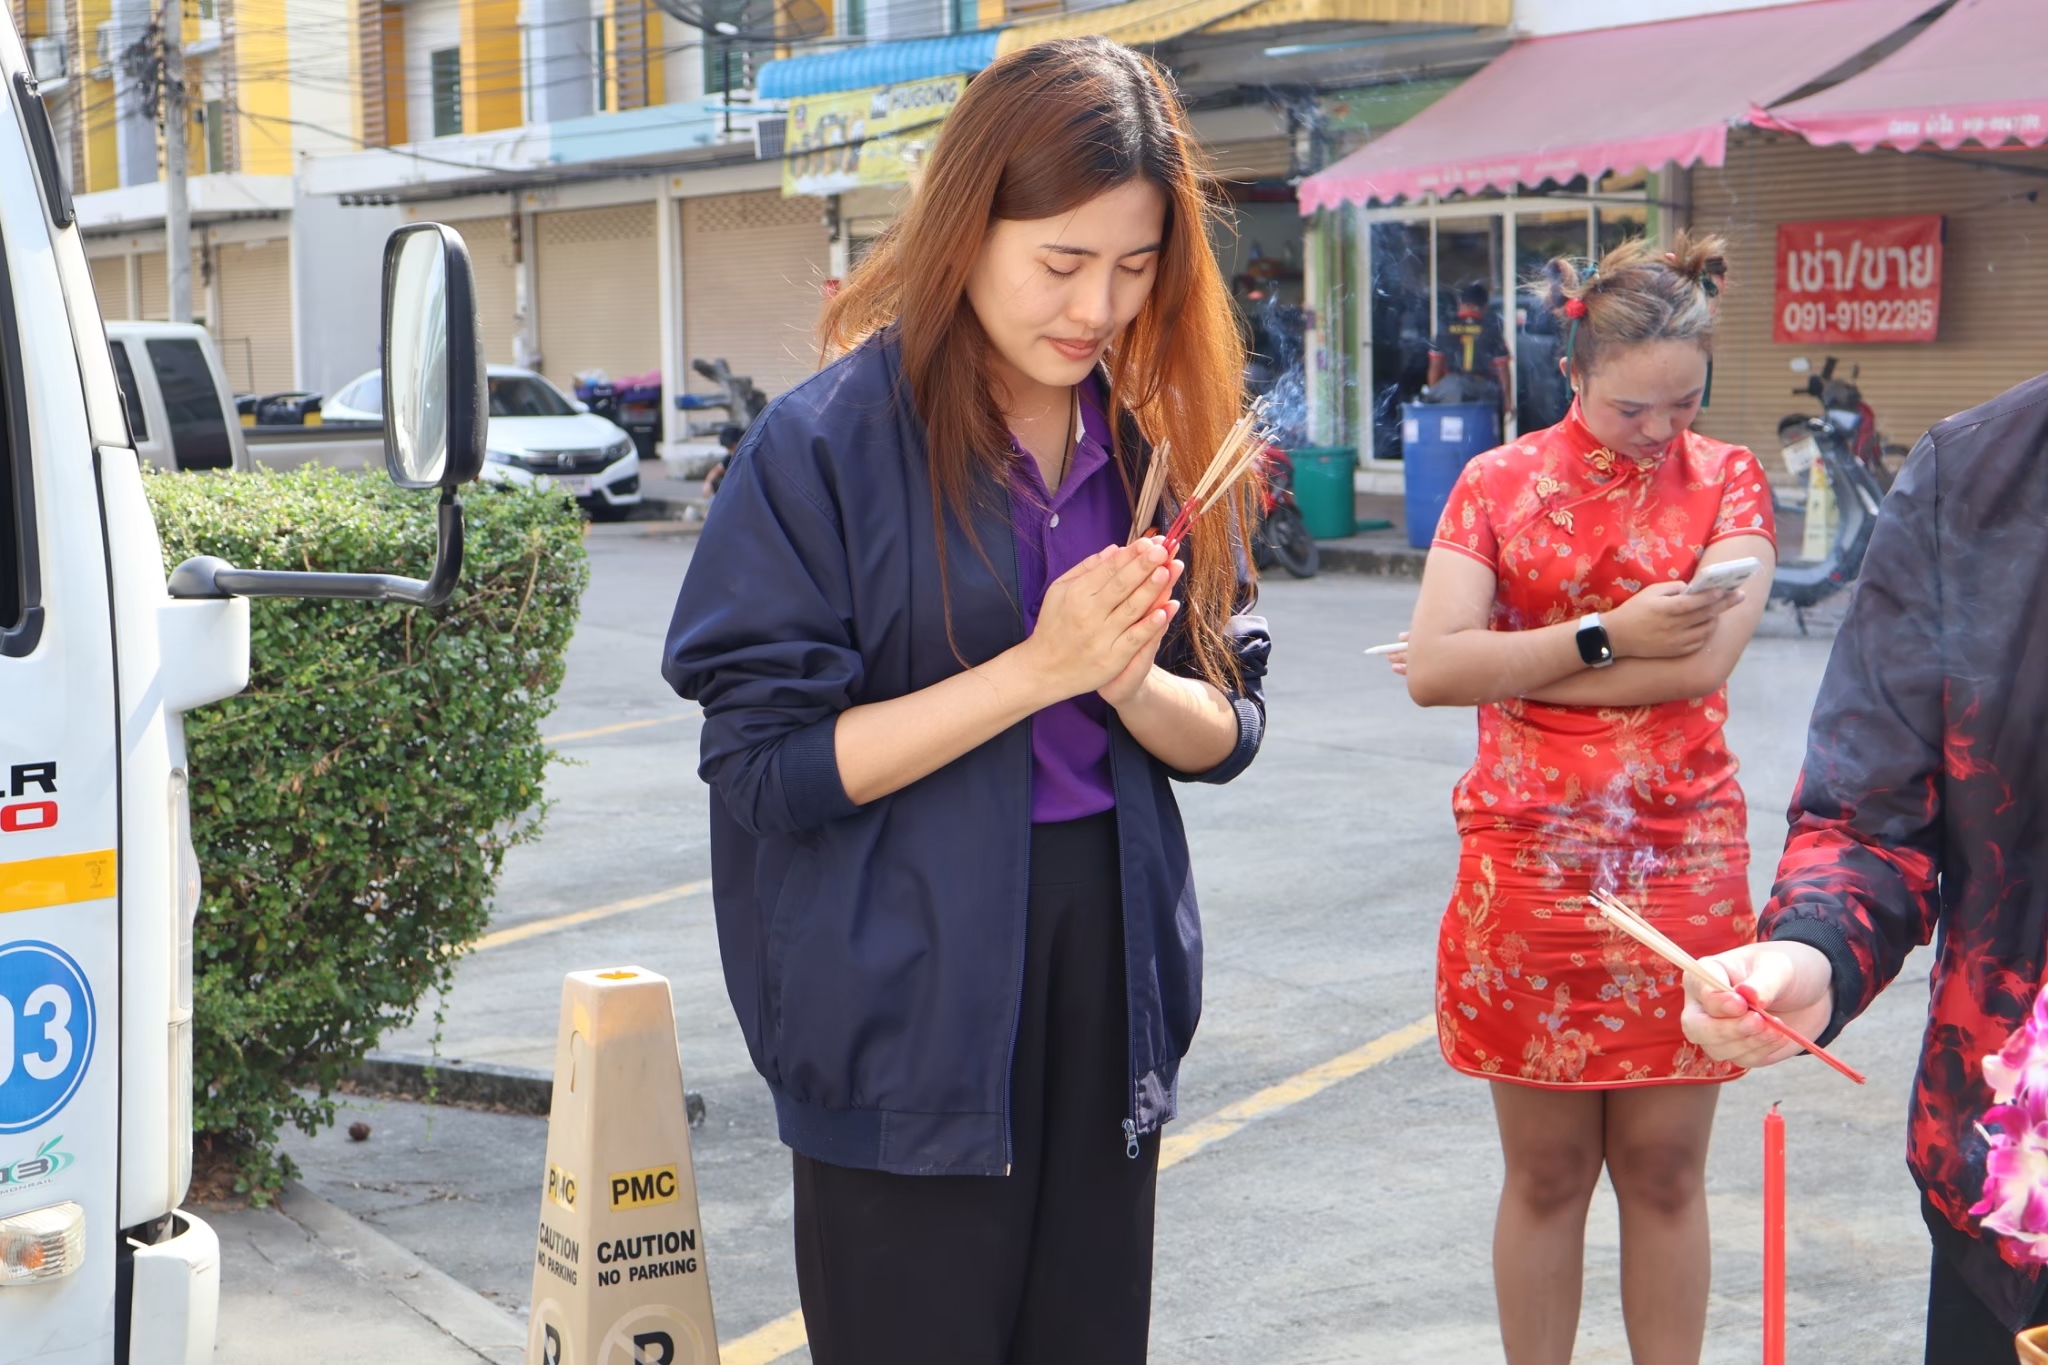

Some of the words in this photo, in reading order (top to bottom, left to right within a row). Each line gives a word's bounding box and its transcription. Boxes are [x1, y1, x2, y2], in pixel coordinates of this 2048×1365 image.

[1788, 231, 1934, 292] เช่า/ขาย
[1783, 299, 1934, 332] 091-9192295
[612, 1171, 675, 1205] PMC
[539, 1222, 579, 1264] CAUTION
[597, 1229, 695, 1264] CAUTION
[538, 1251, 546, 1267] NO
[548, 1257, 577, 1286] PARKING
[598, 1270, 621, 1287] NO
[629, 1258, 697, 1282] PARKING
